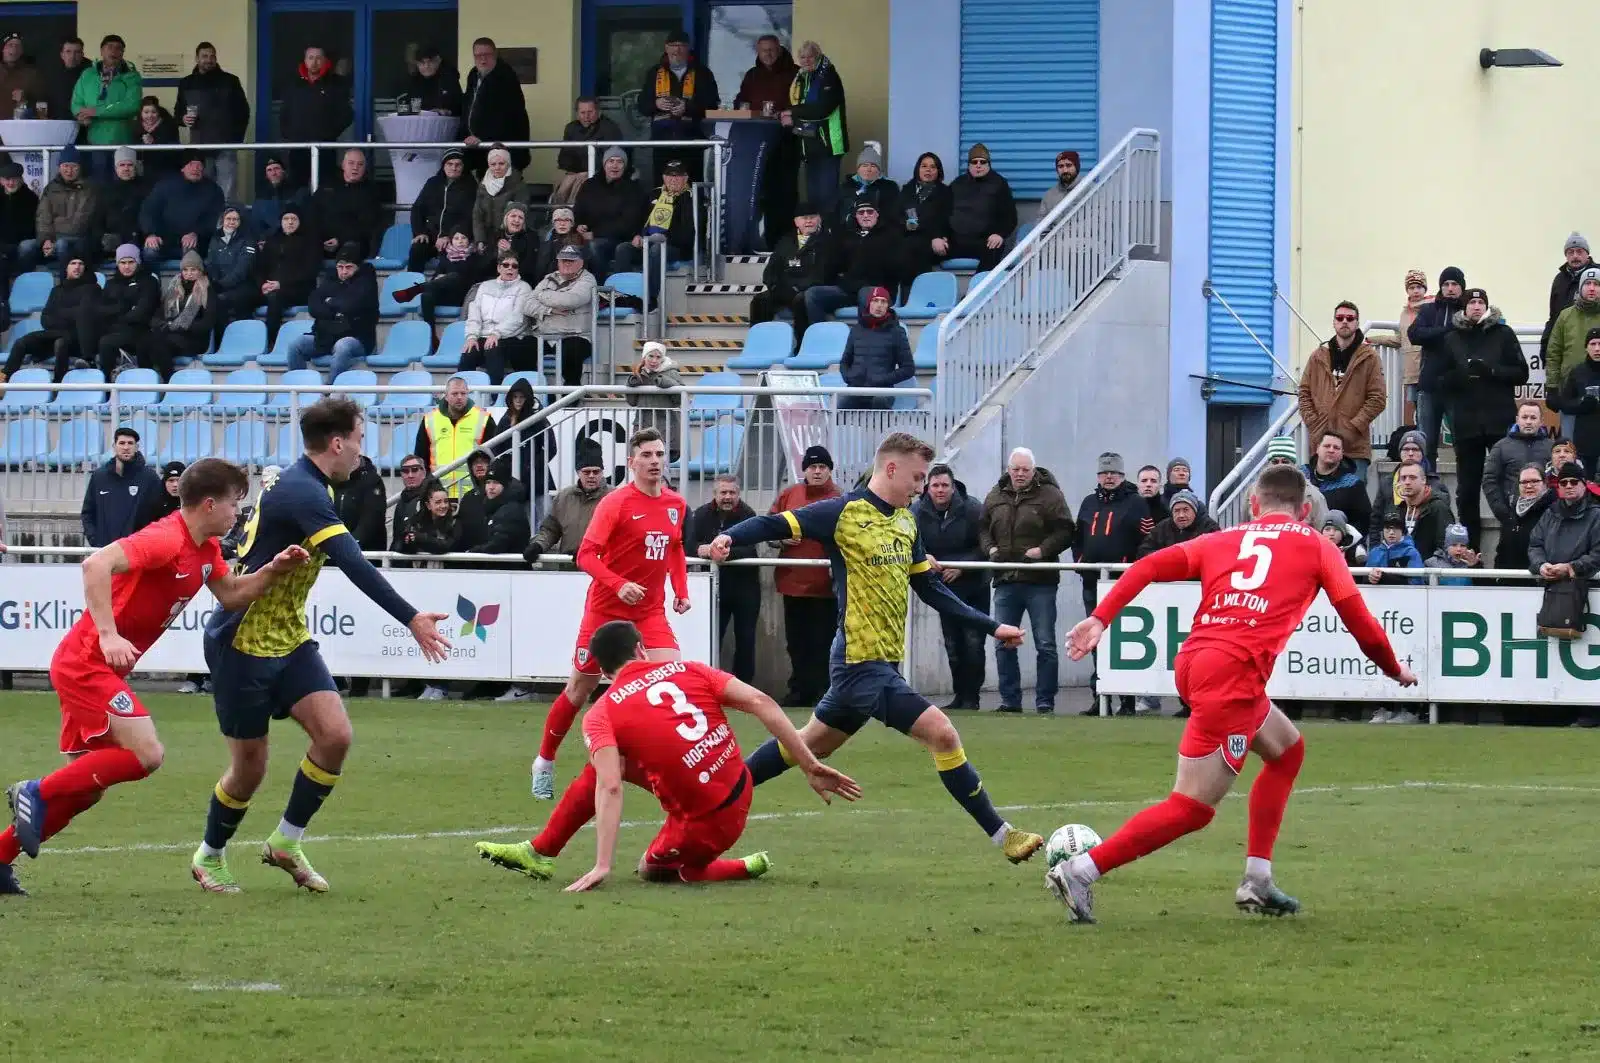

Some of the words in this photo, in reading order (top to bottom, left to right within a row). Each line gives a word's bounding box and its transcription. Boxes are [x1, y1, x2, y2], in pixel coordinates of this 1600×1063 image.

[1229, 530, 1281, 591] 5
[609, 660, 686, 705] BABELSBERG
[646, 680, 709, 742] 3
